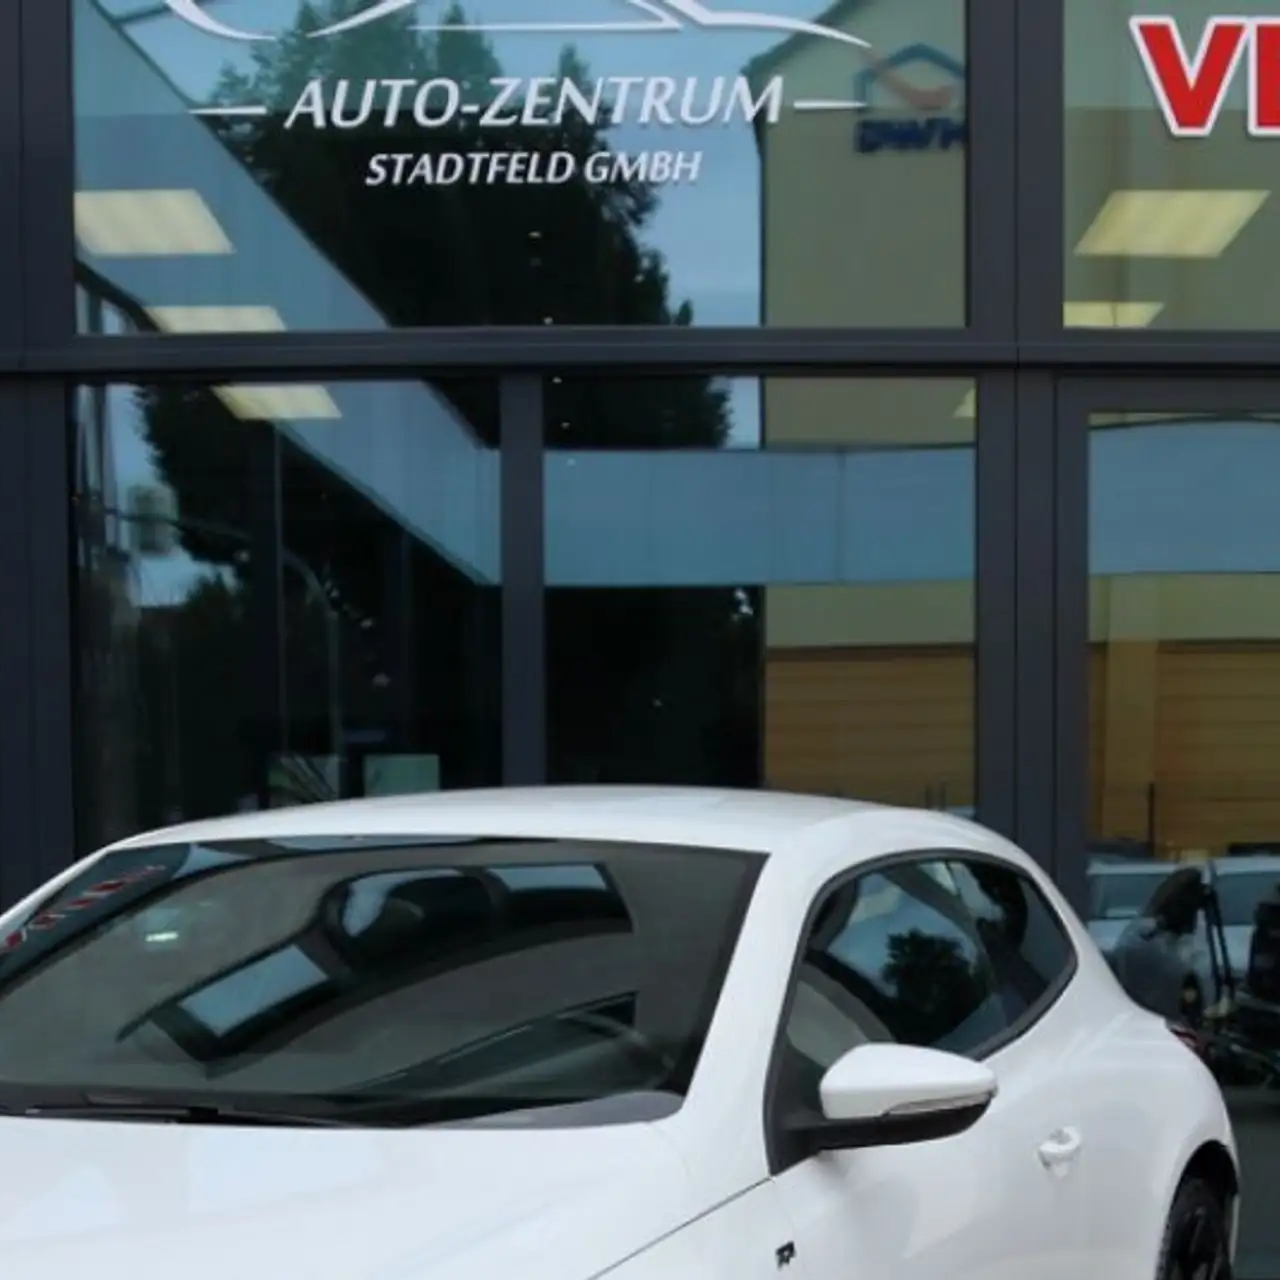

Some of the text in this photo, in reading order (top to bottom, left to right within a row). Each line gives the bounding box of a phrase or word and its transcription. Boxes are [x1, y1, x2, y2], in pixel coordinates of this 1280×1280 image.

[284, 74, 784, 128] AUTO-ZENTRUM
[365, 150, 703, 186] STADTFELD GMBH
